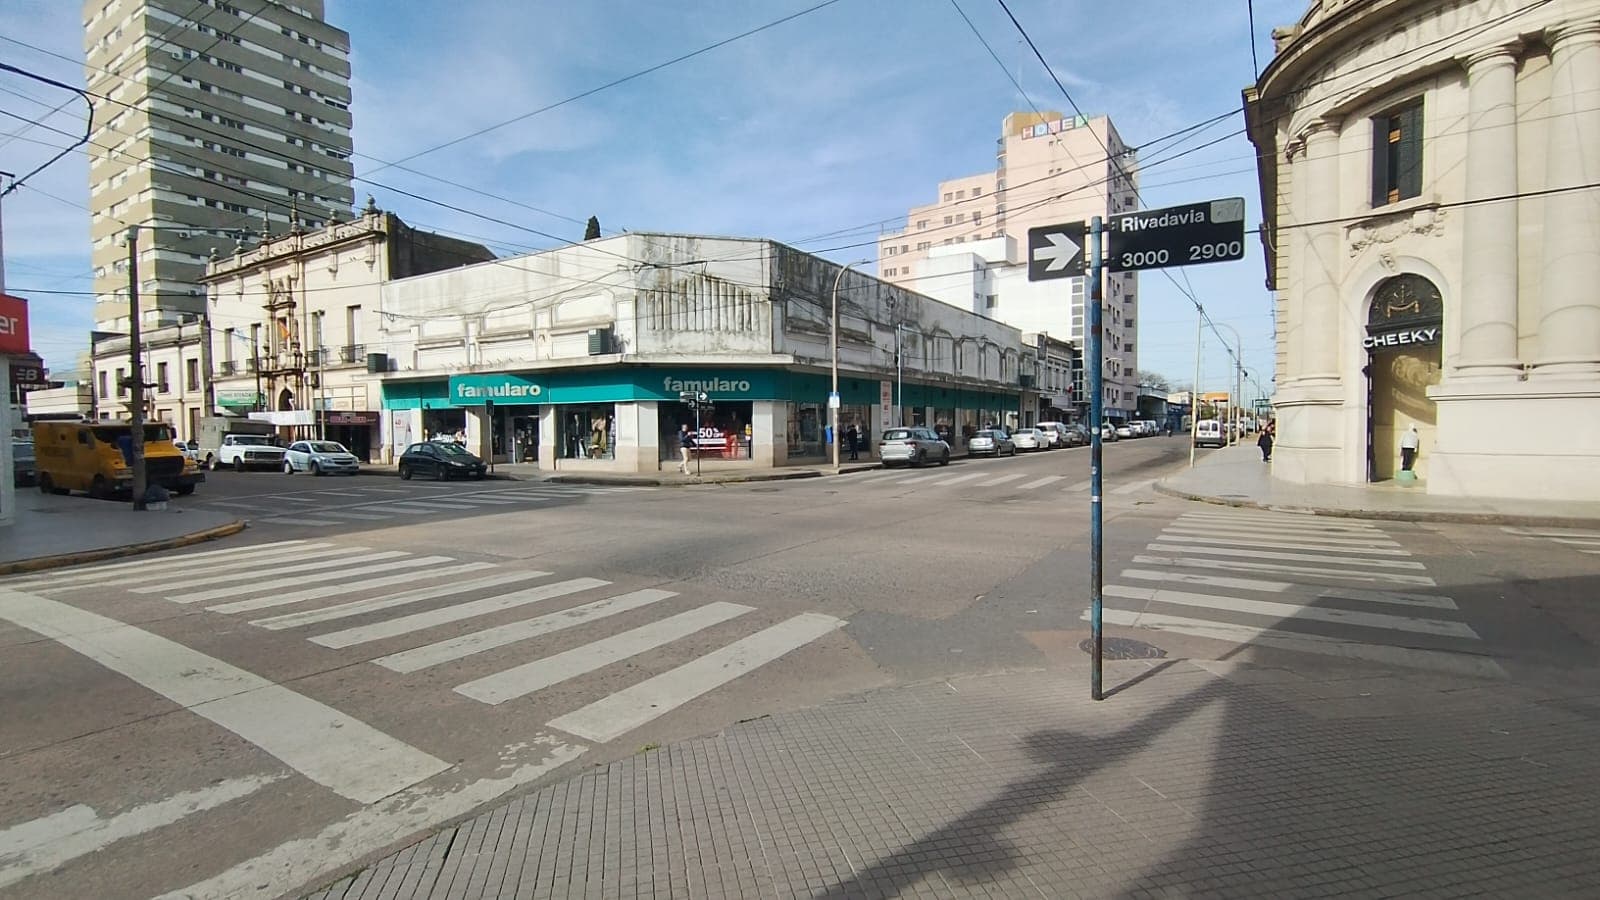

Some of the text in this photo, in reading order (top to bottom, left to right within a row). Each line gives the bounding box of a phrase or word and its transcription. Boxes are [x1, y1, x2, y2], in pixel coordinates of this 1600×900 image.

[1121, 209, 1205, 233] Rivadavia
[1121, 240, 1241, 268] 3000 2900
[1362, 328, 1437, 348] CHEEKY
[457, 382, 541, 397] famularo
[663, 377, 750, 392] famularo
